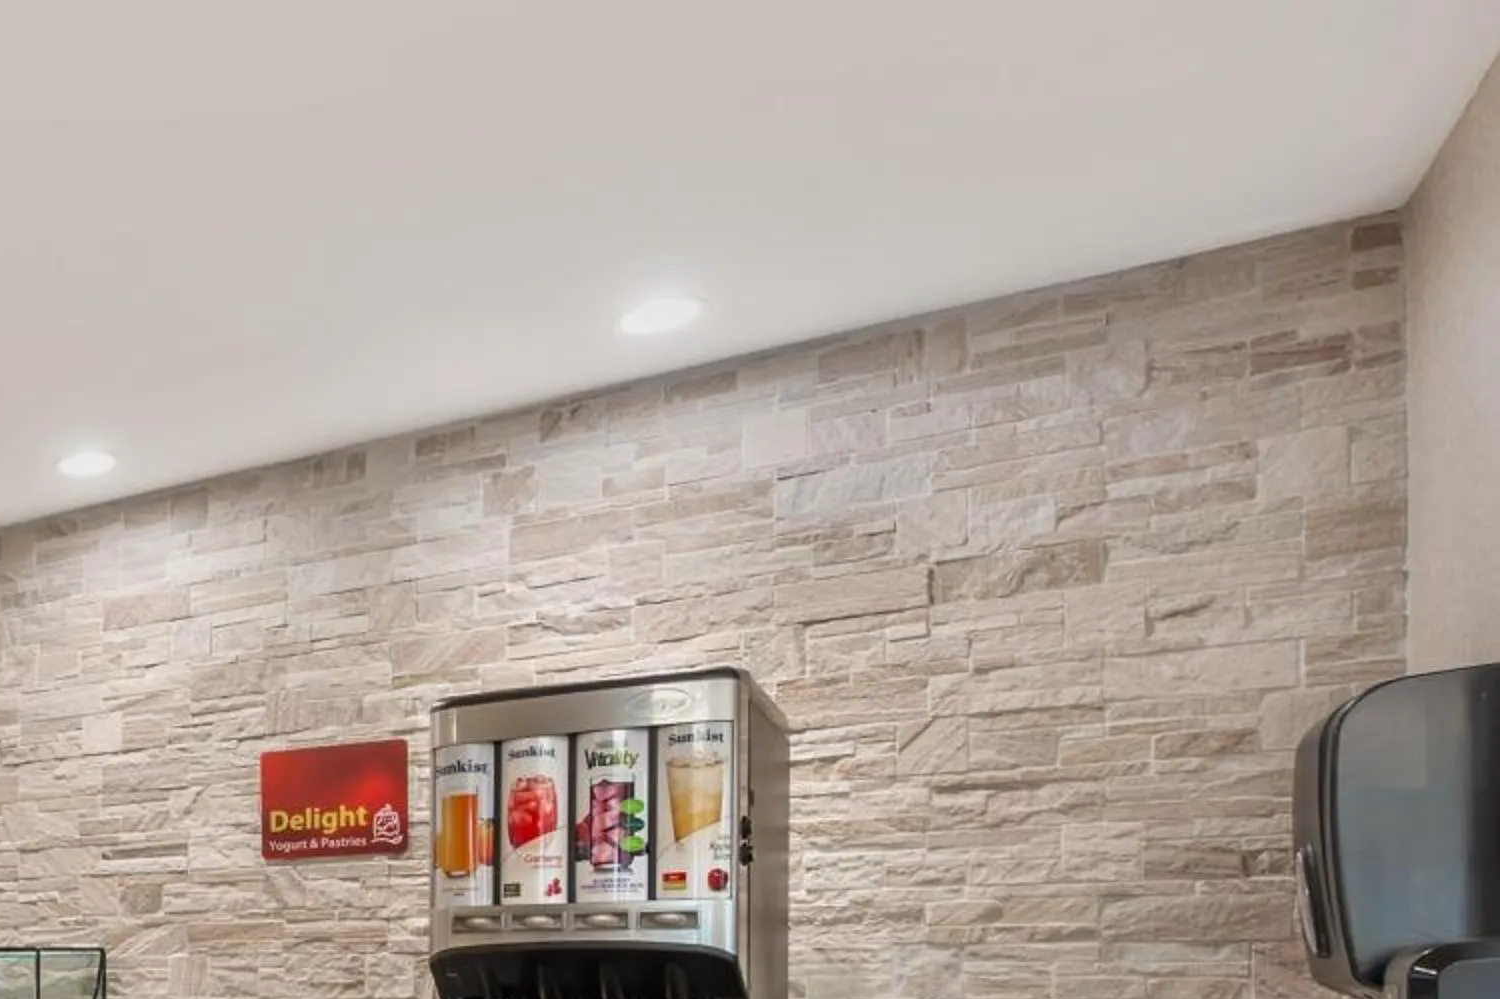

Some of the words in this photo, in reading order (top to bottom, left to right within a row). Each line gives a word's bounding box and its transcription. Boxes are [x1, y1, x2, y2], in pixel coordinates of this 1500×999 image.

[584, 748, 639, 769] Vitality
[269, 804, 368, 835] Delight
[269, 838, 307, 853] Yogurt
[309, 837, 319, 849] &
[321, 836, 368, 849] Pastries
